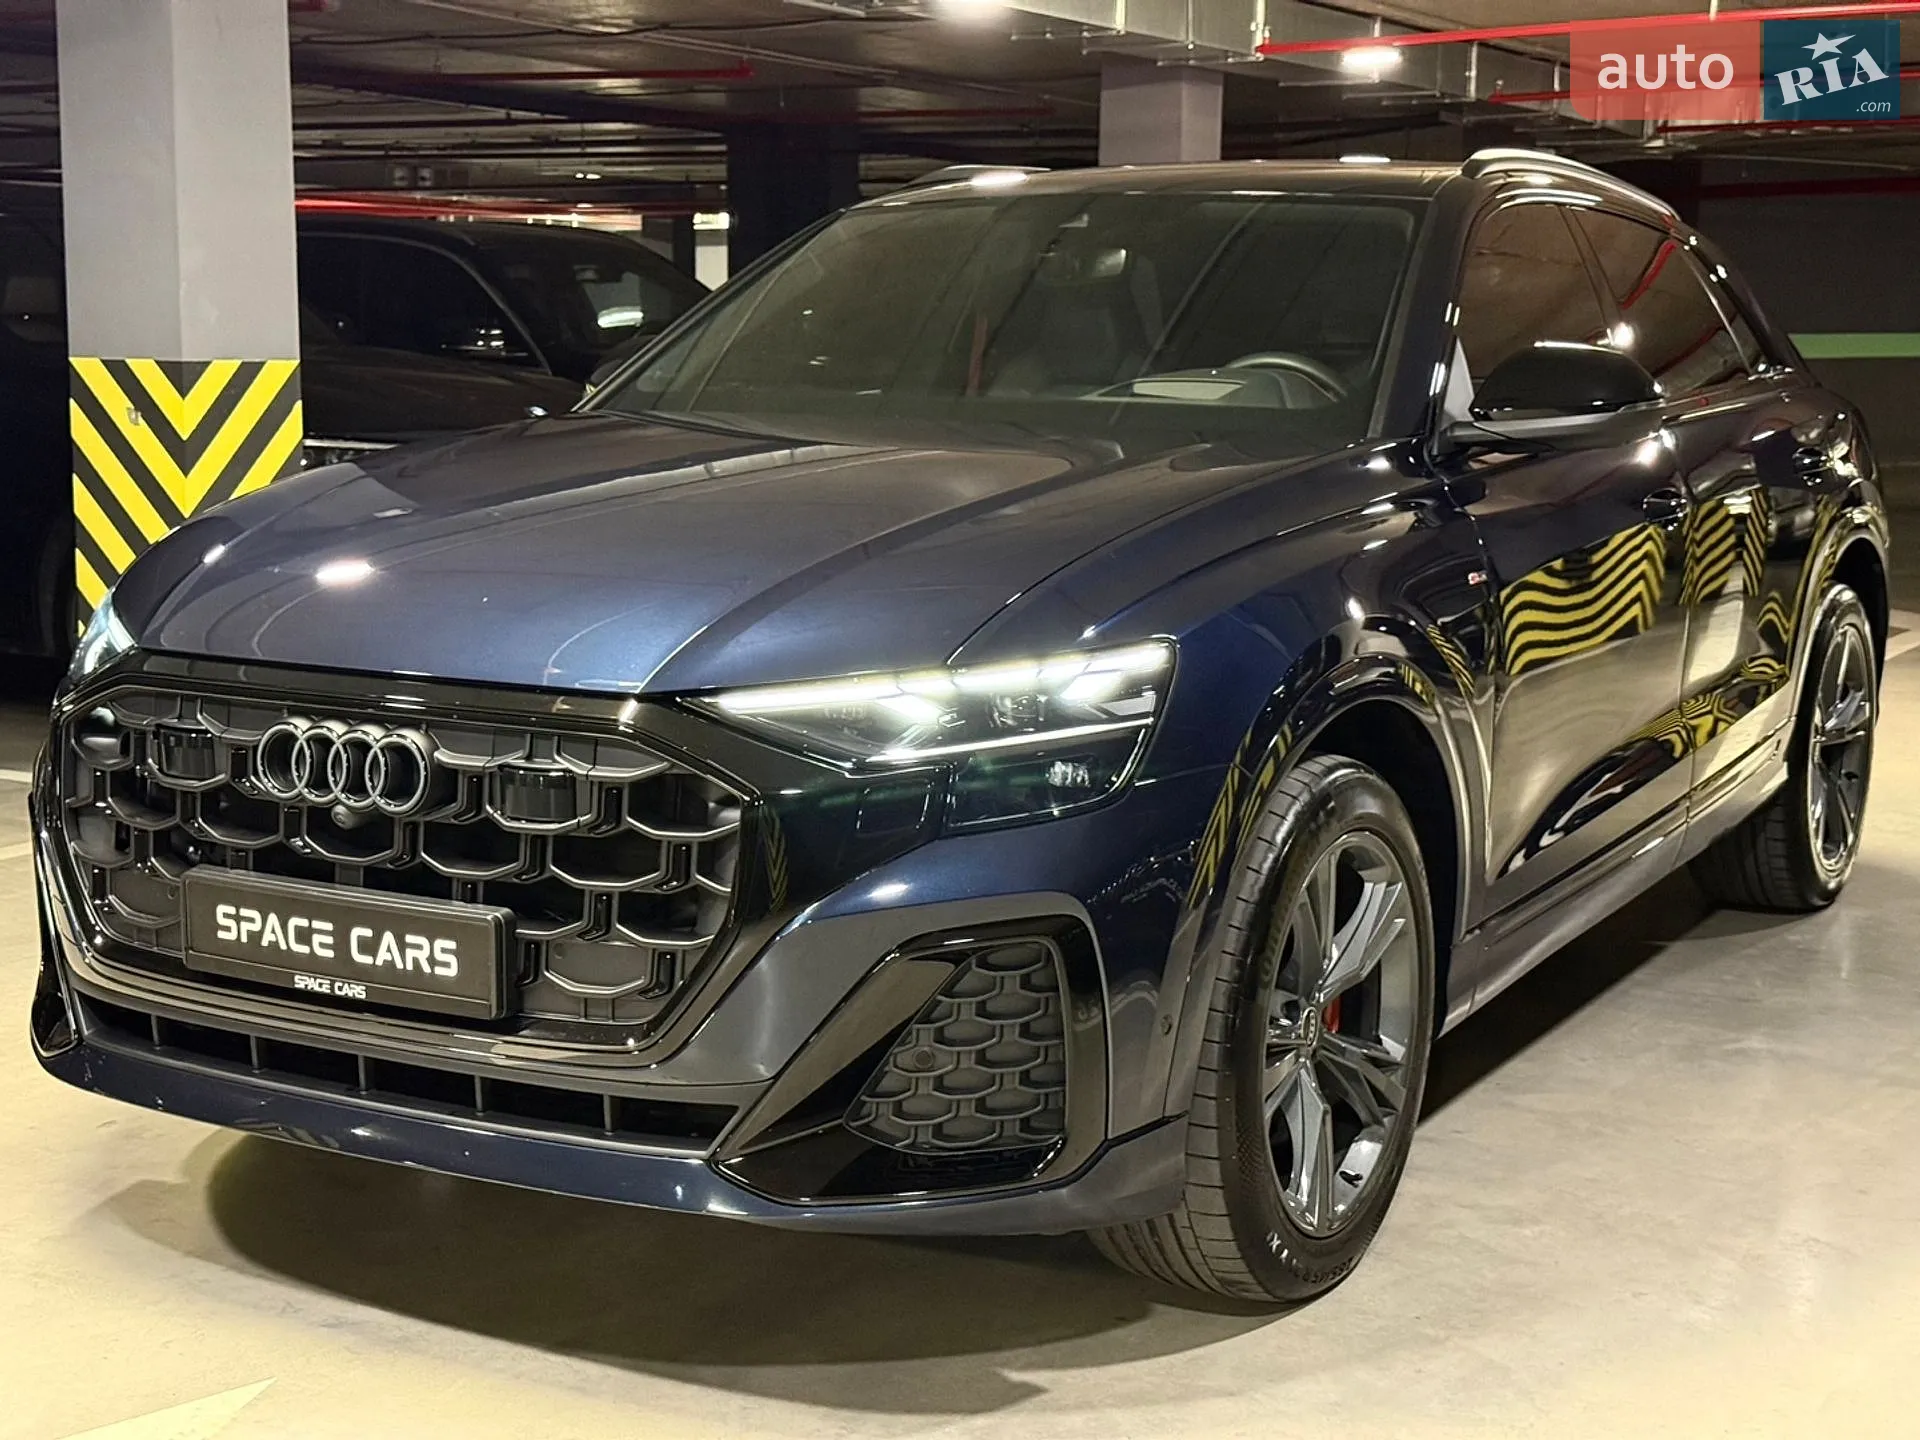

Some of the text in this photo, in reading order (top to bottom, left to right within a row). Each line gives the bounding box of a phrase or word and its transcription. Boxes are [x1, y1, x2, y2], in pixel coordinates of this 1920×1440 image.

[215, 903, 459, 978] SPACE CARS
[294, 974, 367, 999] SPACE CARS
